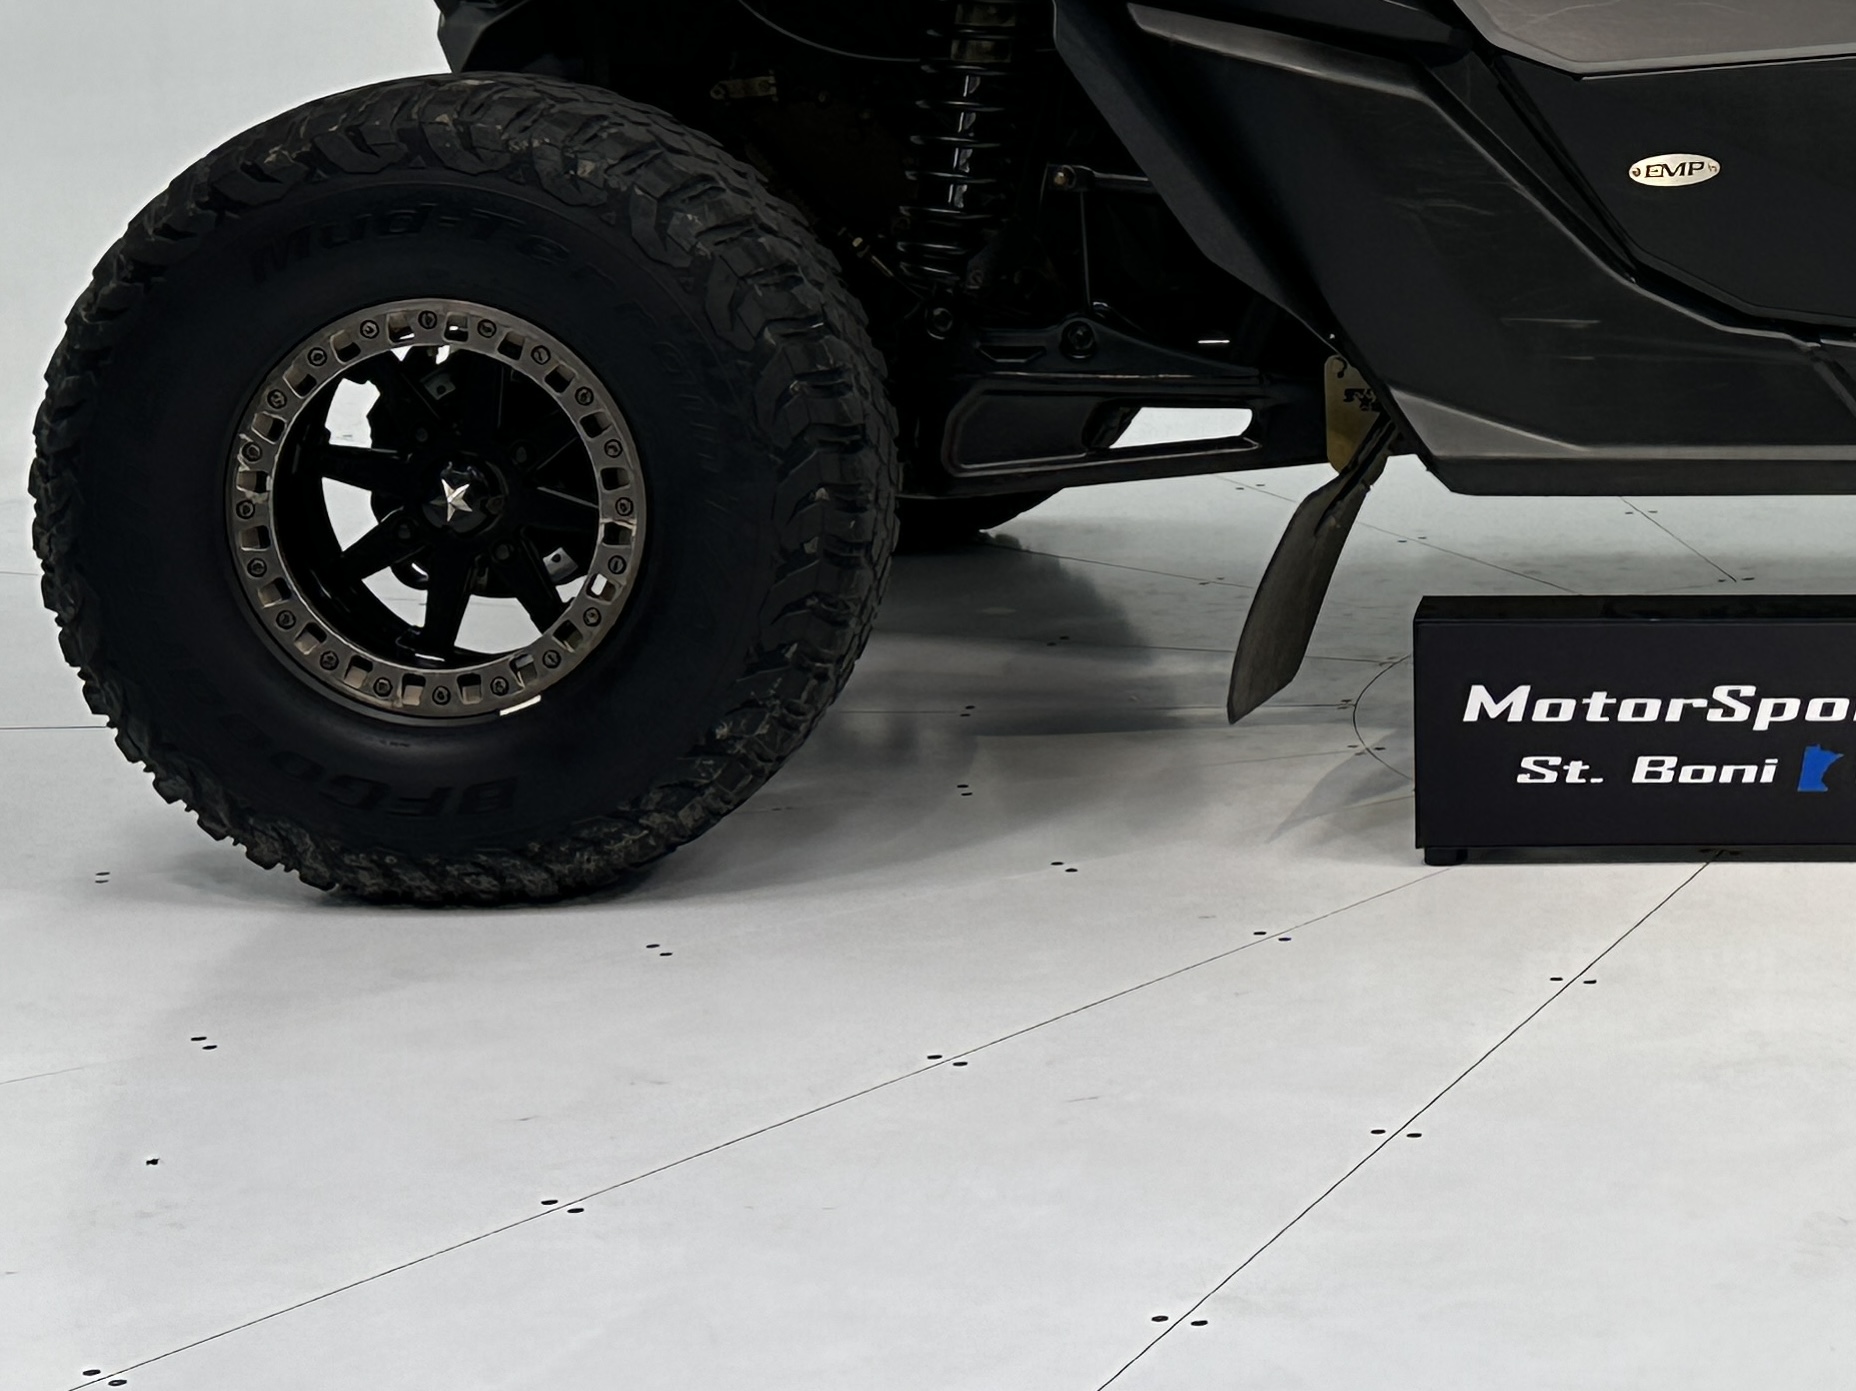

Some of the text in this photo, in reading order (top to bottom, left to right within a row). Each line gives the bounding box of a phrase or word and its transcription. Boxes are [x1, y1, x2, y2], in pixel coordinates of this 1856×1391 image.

[1645, 161, 1705, 178] EMP
[1516, 755, 1604, 784] St.
[1631, 755, 1779, 784] Boni
